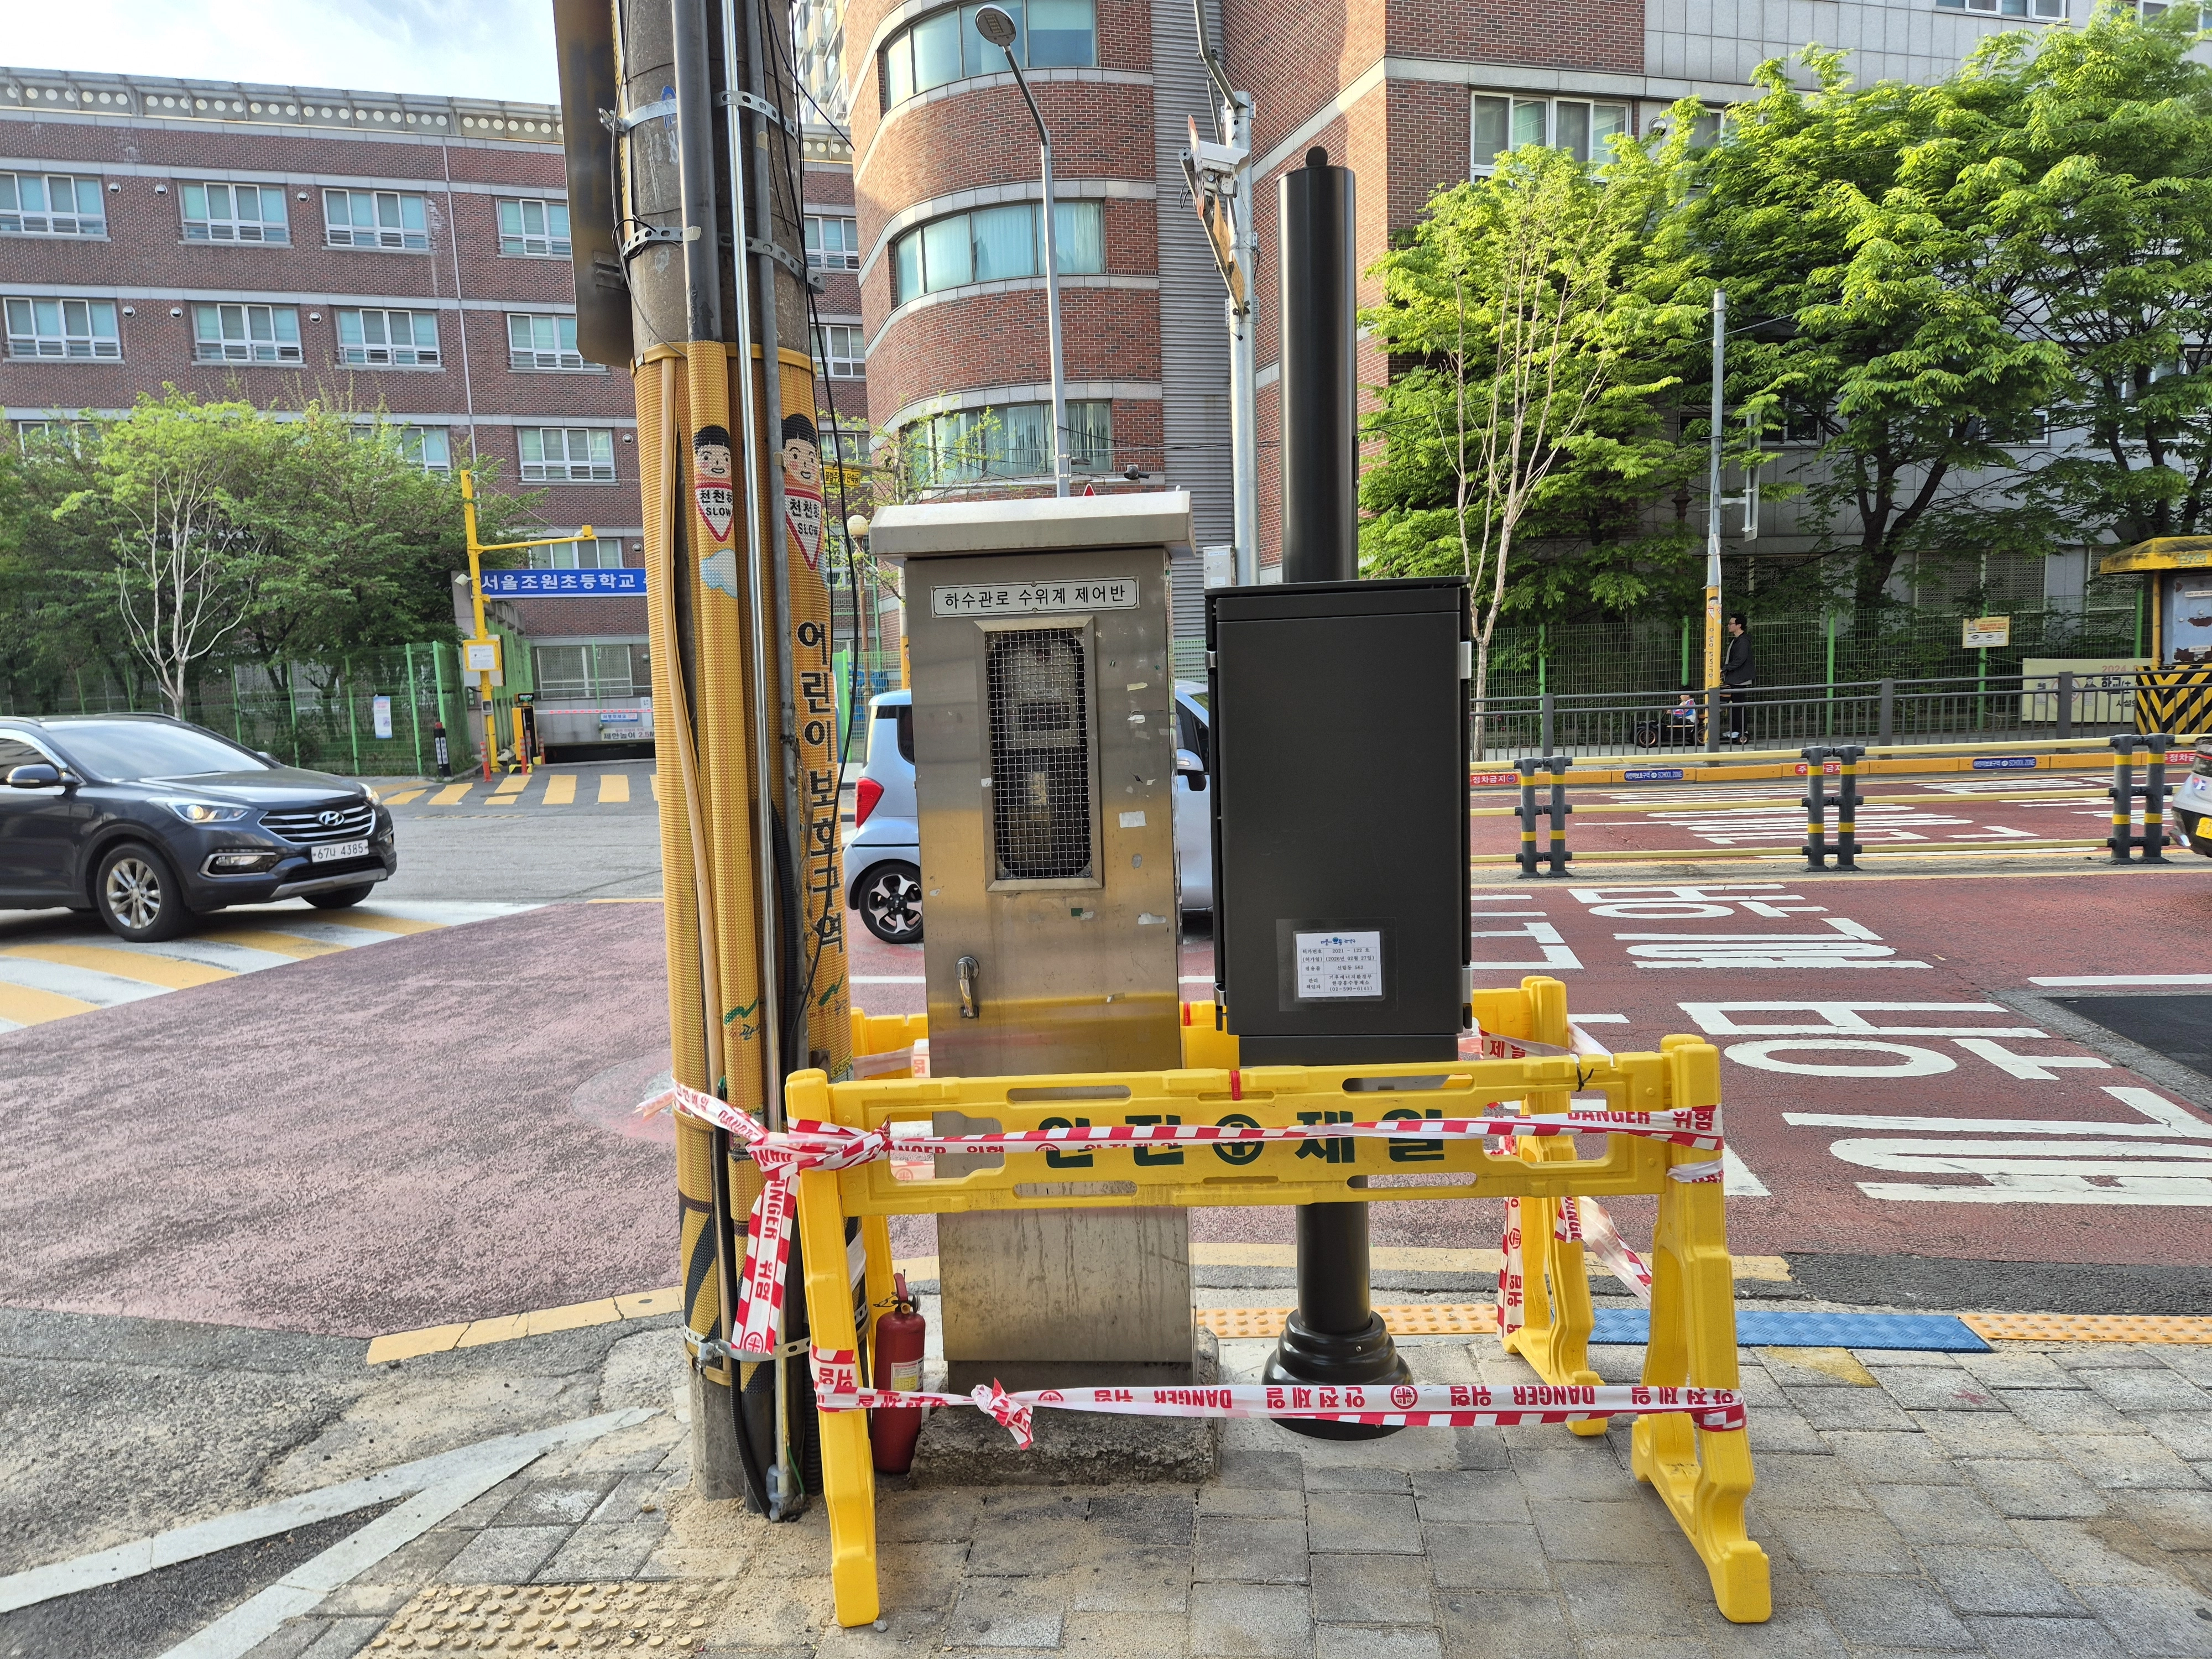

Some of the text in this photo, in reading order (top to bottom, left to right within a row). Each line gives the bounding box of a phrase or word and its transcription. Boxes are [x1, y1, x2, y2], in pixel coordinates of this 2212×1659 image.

[706, 507, 731, 517] SLOW
[482, 573, 636, 591] 서울조원초등학교
[944, 585, 1126, 609] 하수관로 수위계 제어반
[796, 621, 845, 954] 어린이보호구역
[1471, 775, 1506, 784] 정차금지
[340, 843, 363, 855] 4385
[763, 1179, 787, 1239] ANGER
[754, 1259, 774, 1302] 위험
[1507, 1274, 1522, 1307] 위험
[1154, 1389, 1233, 1409] DANGER
[1266, 1386, 1365, 1410] 안전제일
[1450, 1385, 1492, 1407] 위험
[1513, 1385, 1596, 1406] DANGER
